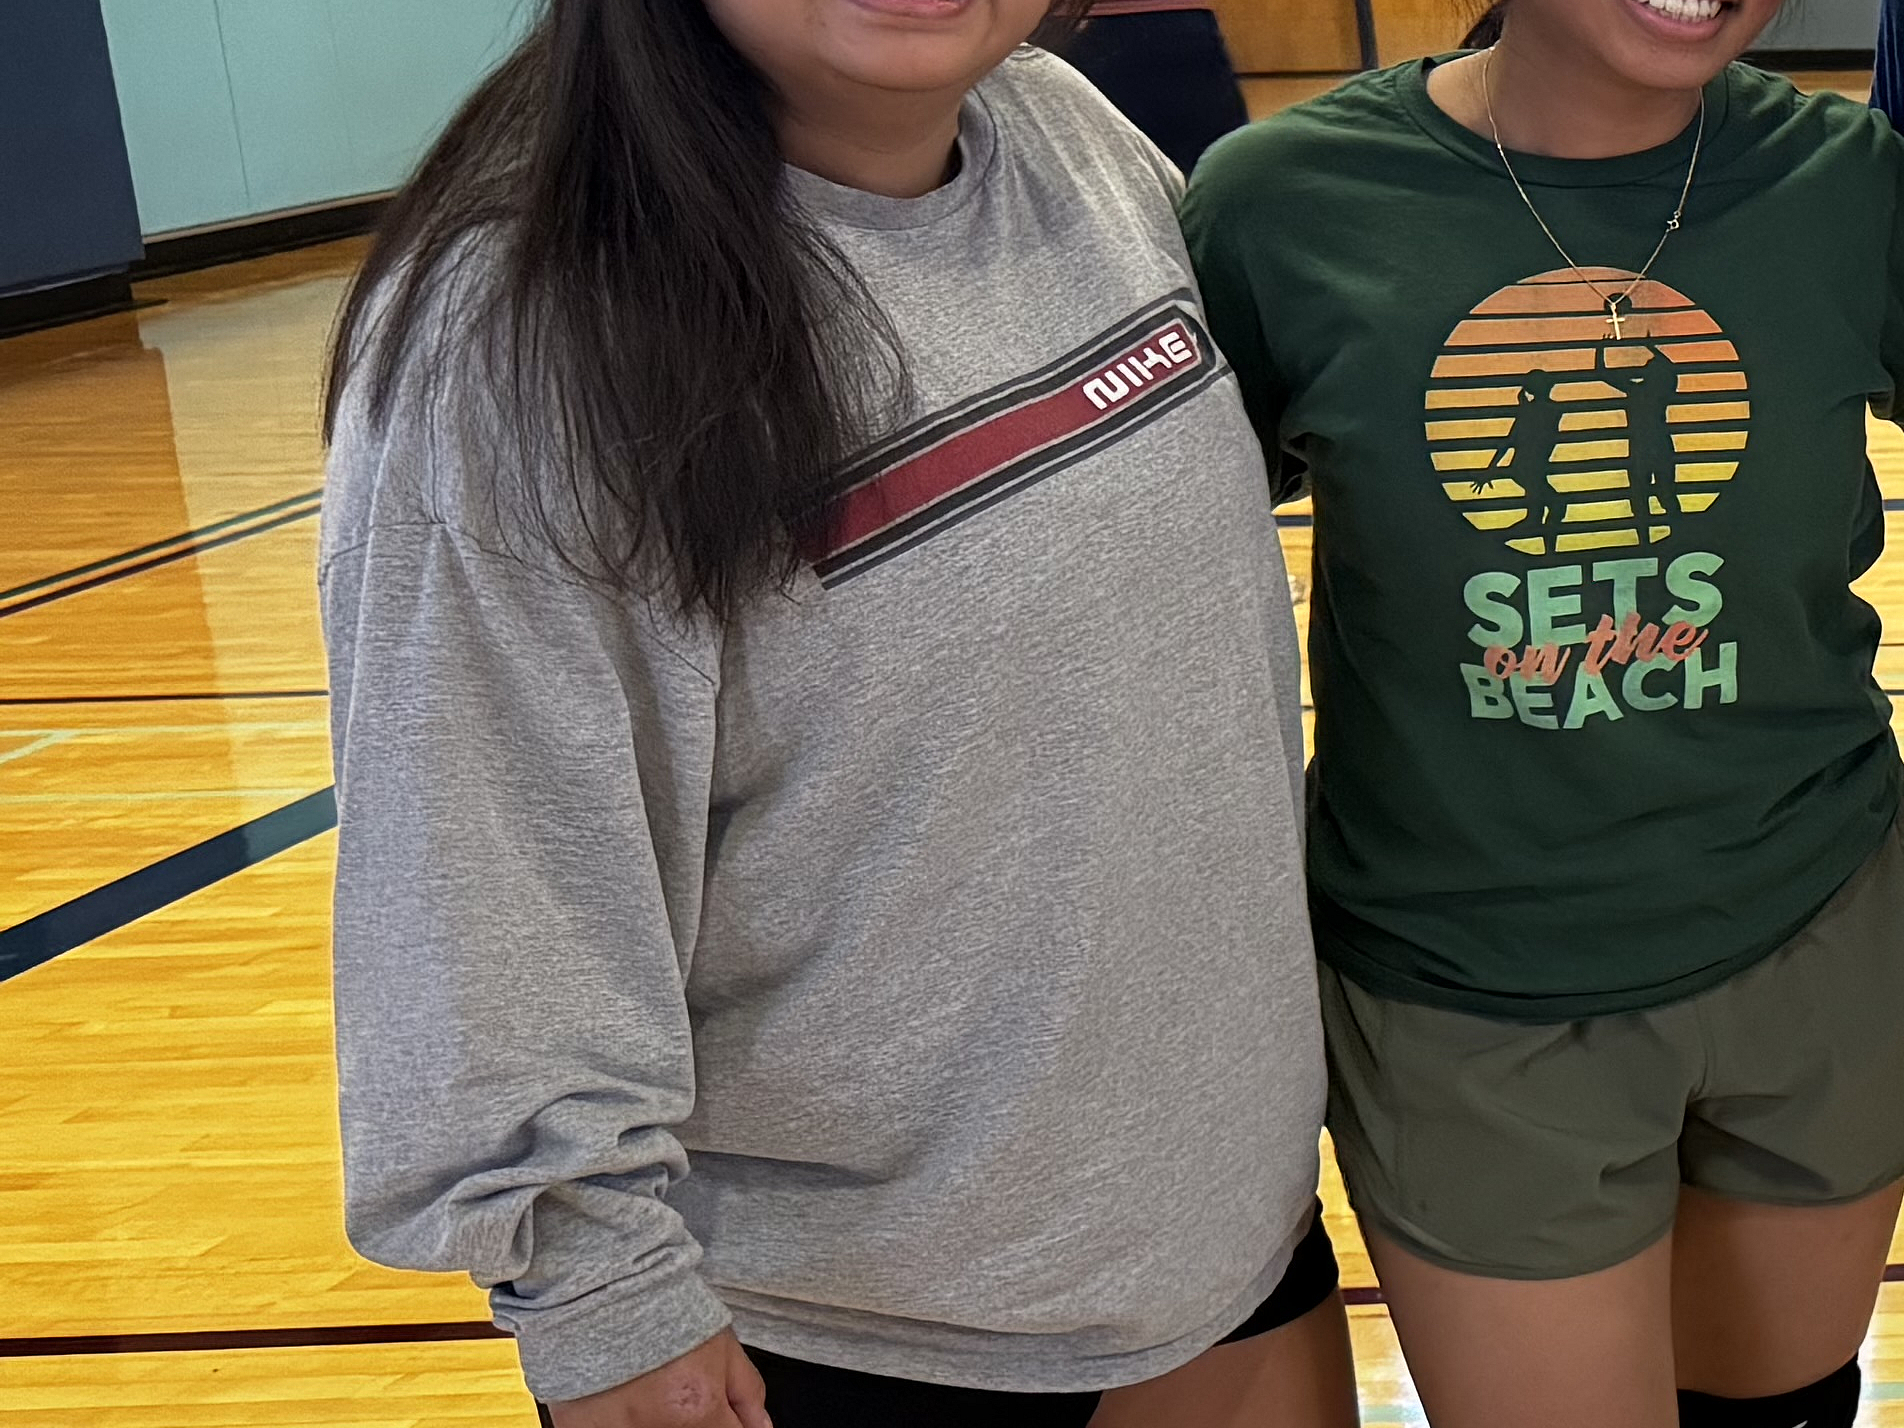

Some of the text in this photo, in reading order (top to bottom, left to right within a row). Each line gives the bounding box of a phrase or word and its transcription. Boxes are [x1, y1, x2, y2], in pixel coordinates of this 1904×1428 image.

[1082, 331, 1193, 410] NIKE
[1463, 551, 1725, 649] SETS
[1460, 641, 1738, 730] BEACH
[1483, 611, 1709, 685] on the
